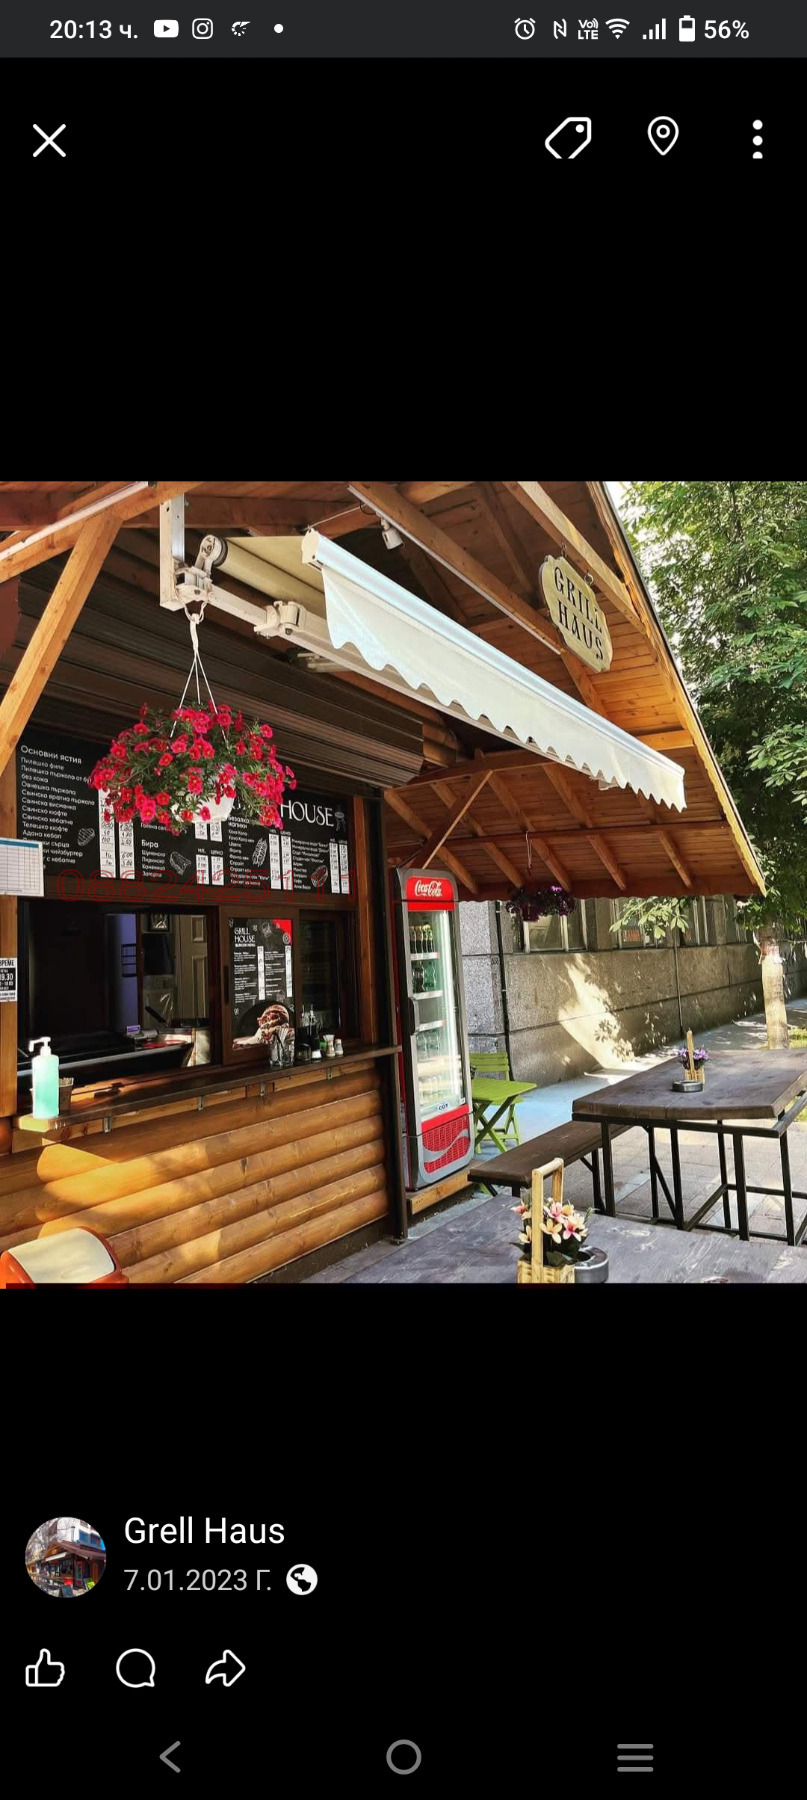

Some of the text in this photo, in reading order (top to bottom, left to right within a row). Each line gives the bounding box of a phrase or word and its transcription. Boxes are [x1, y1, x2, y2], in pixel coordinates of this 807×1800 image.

[554, 566, 602, 634] GRILL
[558, 599, 603, 660] HAUS
[21, 745, 82, 764] Основни ястия
[281, 799, 334, 827] HOUSE
[141, 839, 159, 849] Бира
[234, 934, 255, 943] HOUSE
